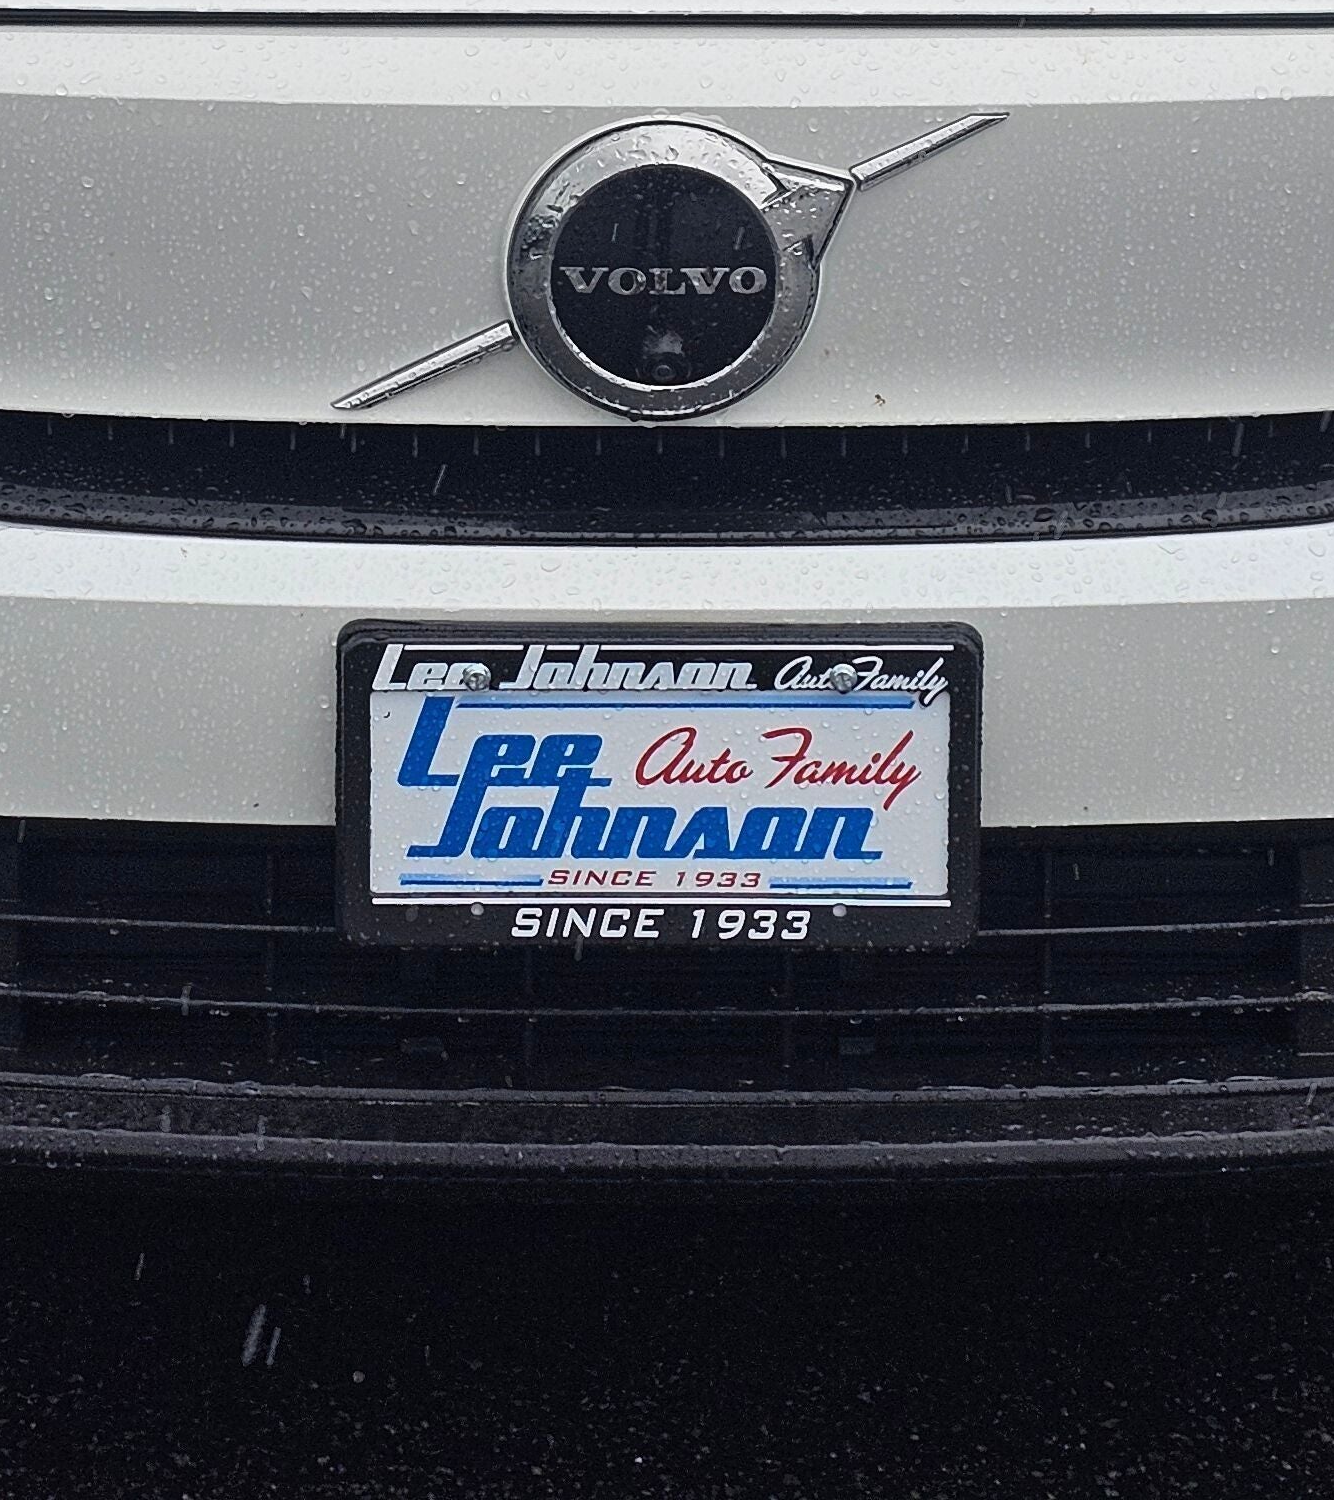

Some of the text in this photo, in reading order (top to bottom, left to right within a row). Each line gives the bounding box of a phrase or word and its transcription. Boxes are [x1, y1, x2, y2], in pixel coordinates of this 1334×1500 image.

[559, 266, 767, 295] VOLVO
[498, 644, 757, 691] Johnson
[773, 655, 853, 691] Aut
[851, 655, 949, 706] Family
[397, 696, 613, 788] Lee
[635, 726, 922, 811] Auto Family
[406, 779, 884, 861] Johnson
[548, 869, 762, 889] SINCE 1933
[511, 907, 812, 941] SINCE 1933
